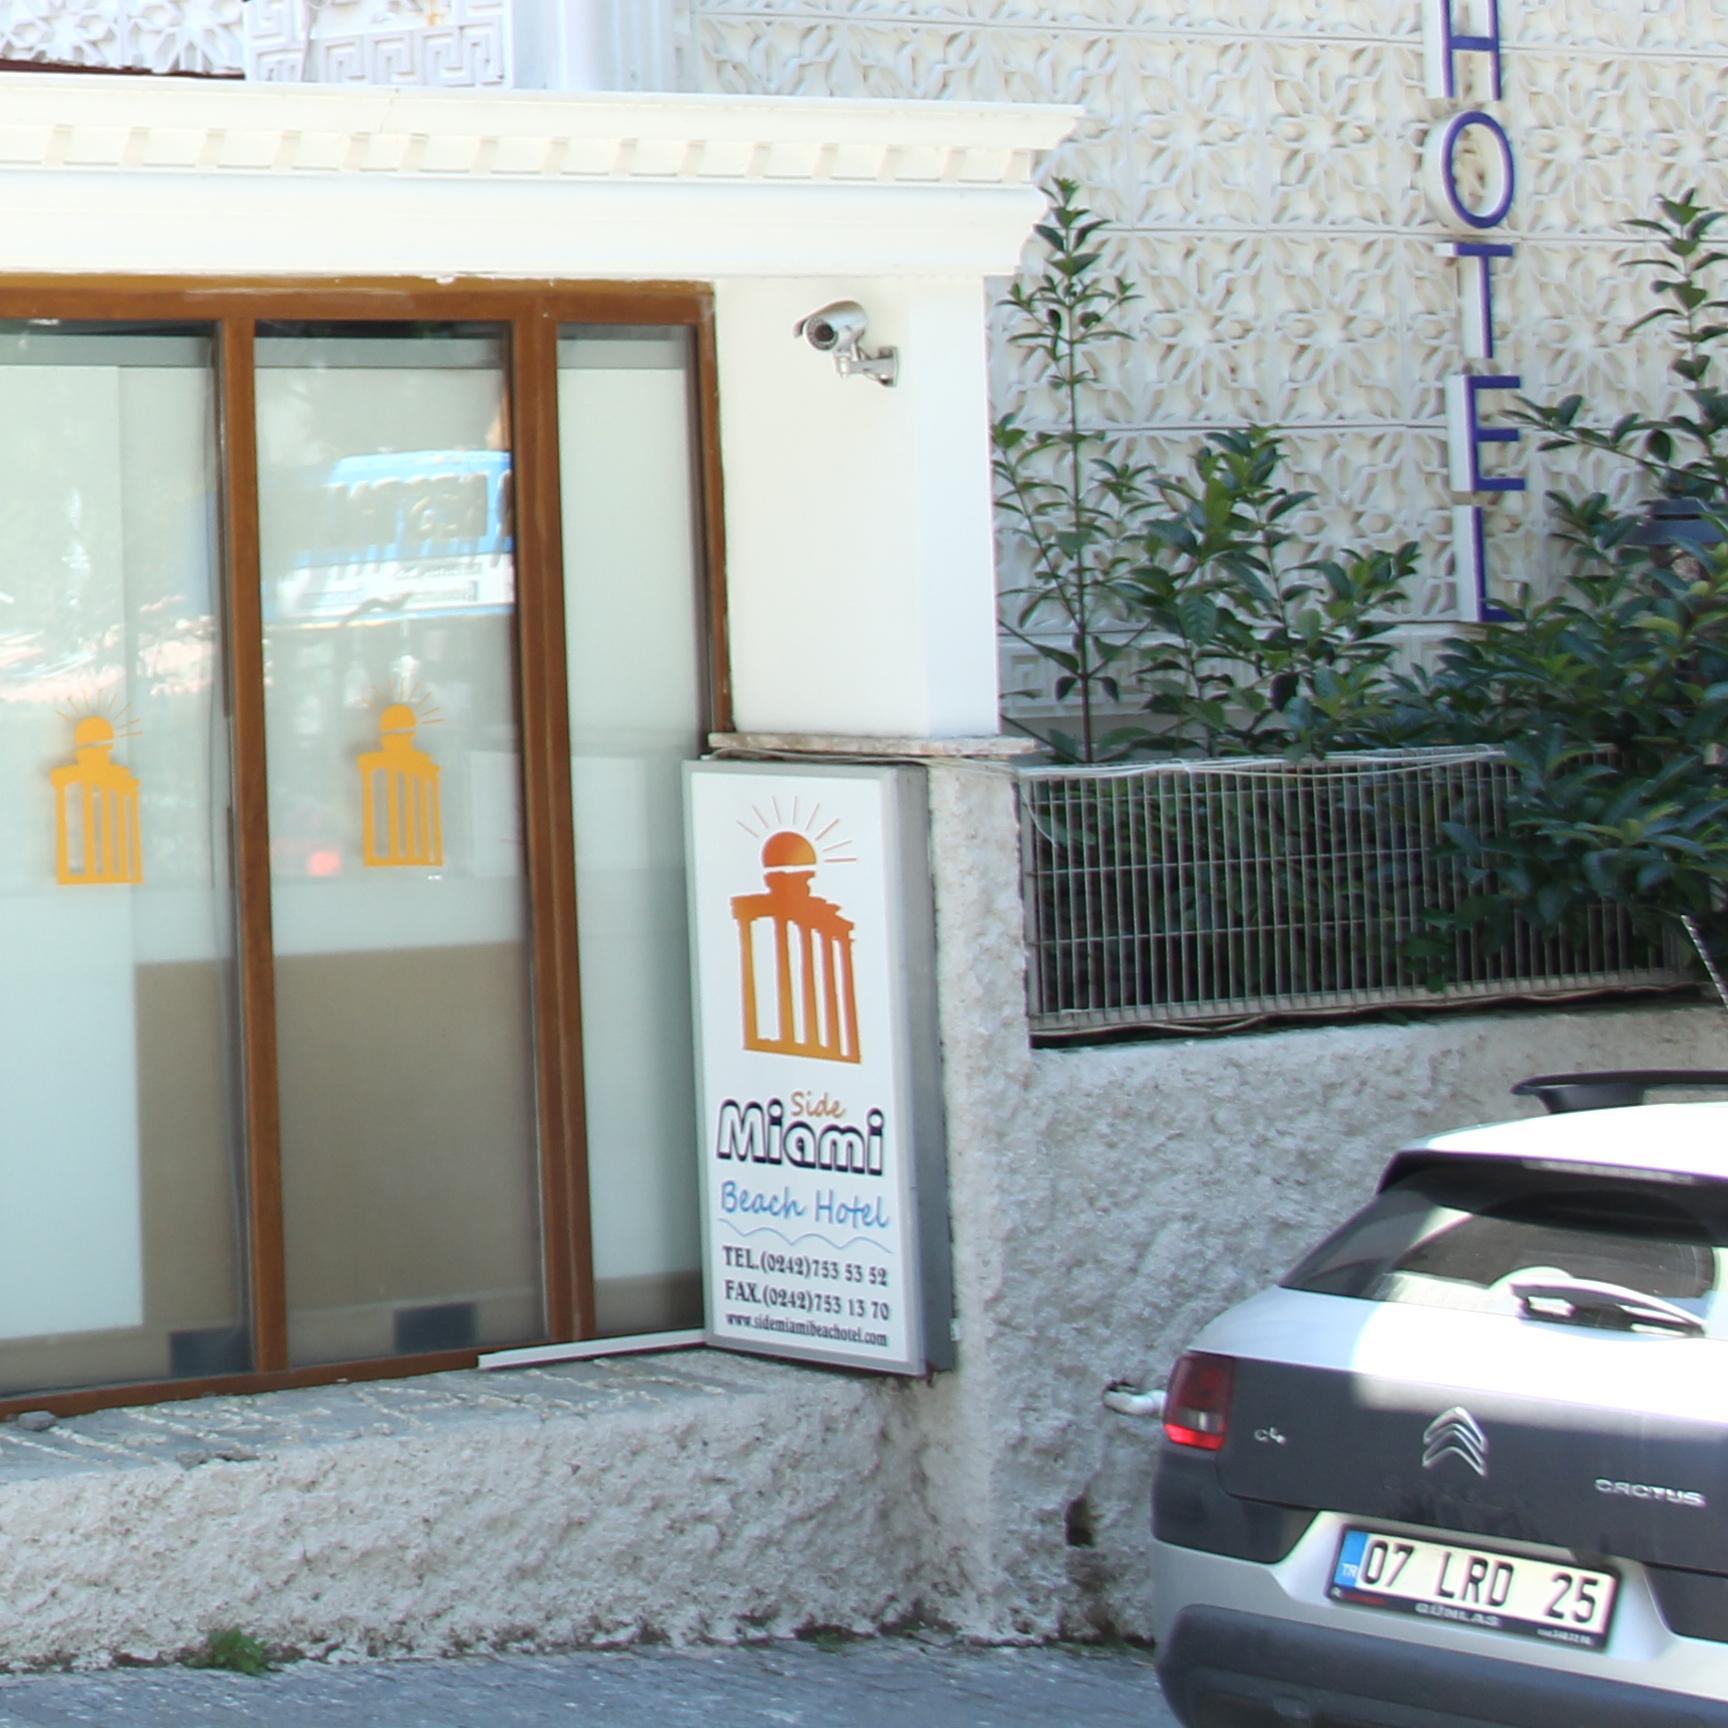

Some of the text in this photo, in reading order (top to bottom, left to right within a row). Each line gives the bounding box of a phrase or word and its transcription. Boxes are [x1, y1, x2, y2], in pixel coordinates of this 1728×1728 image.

[790, 1090, 846, 1120] Side
[716, 1098, 885, 1177] Miami
[721, 1179, 892, 1230] Beach Hotel
[845, 1263, 864, 1283] 53
[868, 1266, 888, 1287] 52
[848, 1299, 866, 1318] 13
[871, 1301, 891, 1321] 70
[1594, 1477, 1706, 1508] CACTUS
[1360, 1539, 1600, 1624] 07 LRD 25
